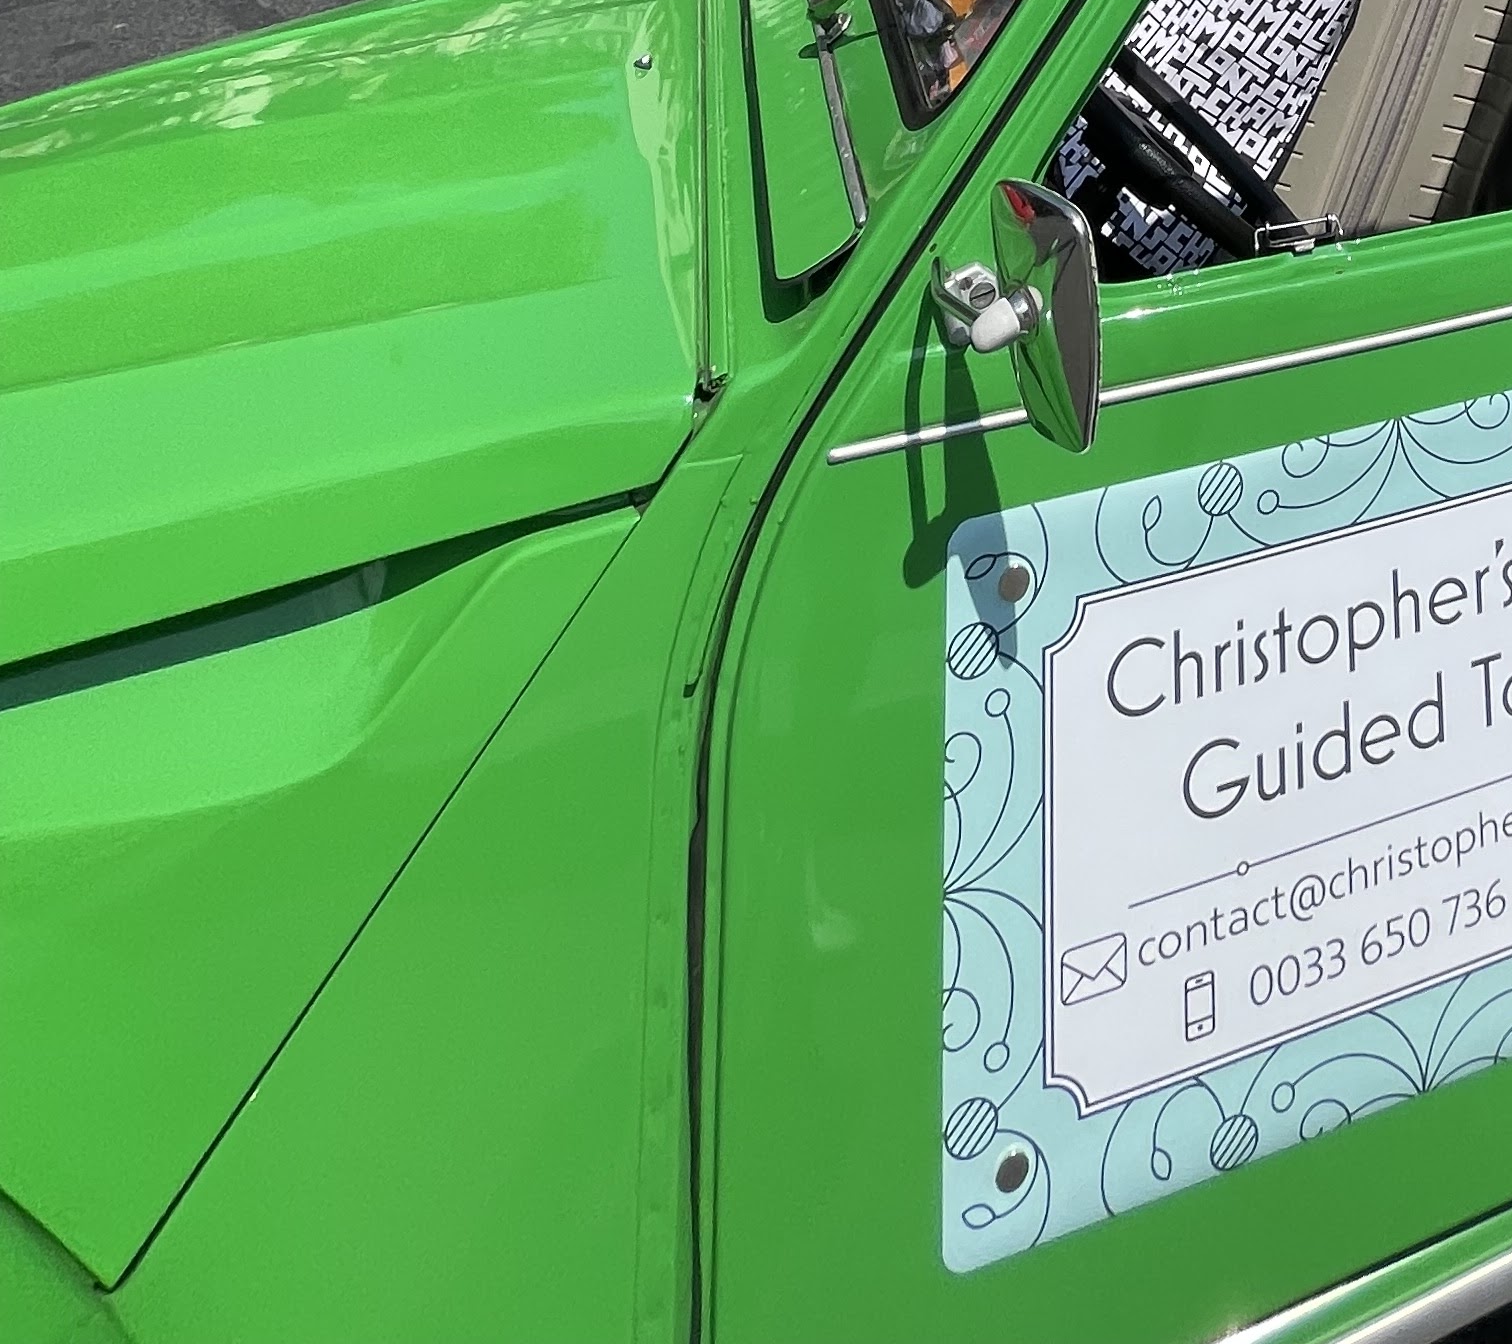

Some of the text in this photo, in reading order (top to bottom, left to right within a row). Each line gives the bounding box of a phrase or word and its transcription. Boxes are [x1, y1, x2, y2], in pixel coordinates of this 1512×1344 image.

[1182, 671, 1447, 820] Guided
[1249, 940, 1348, 1008] 0033
[1359, 908, 1431, 959] 650
[1442, 885, 1508, 939] 736
